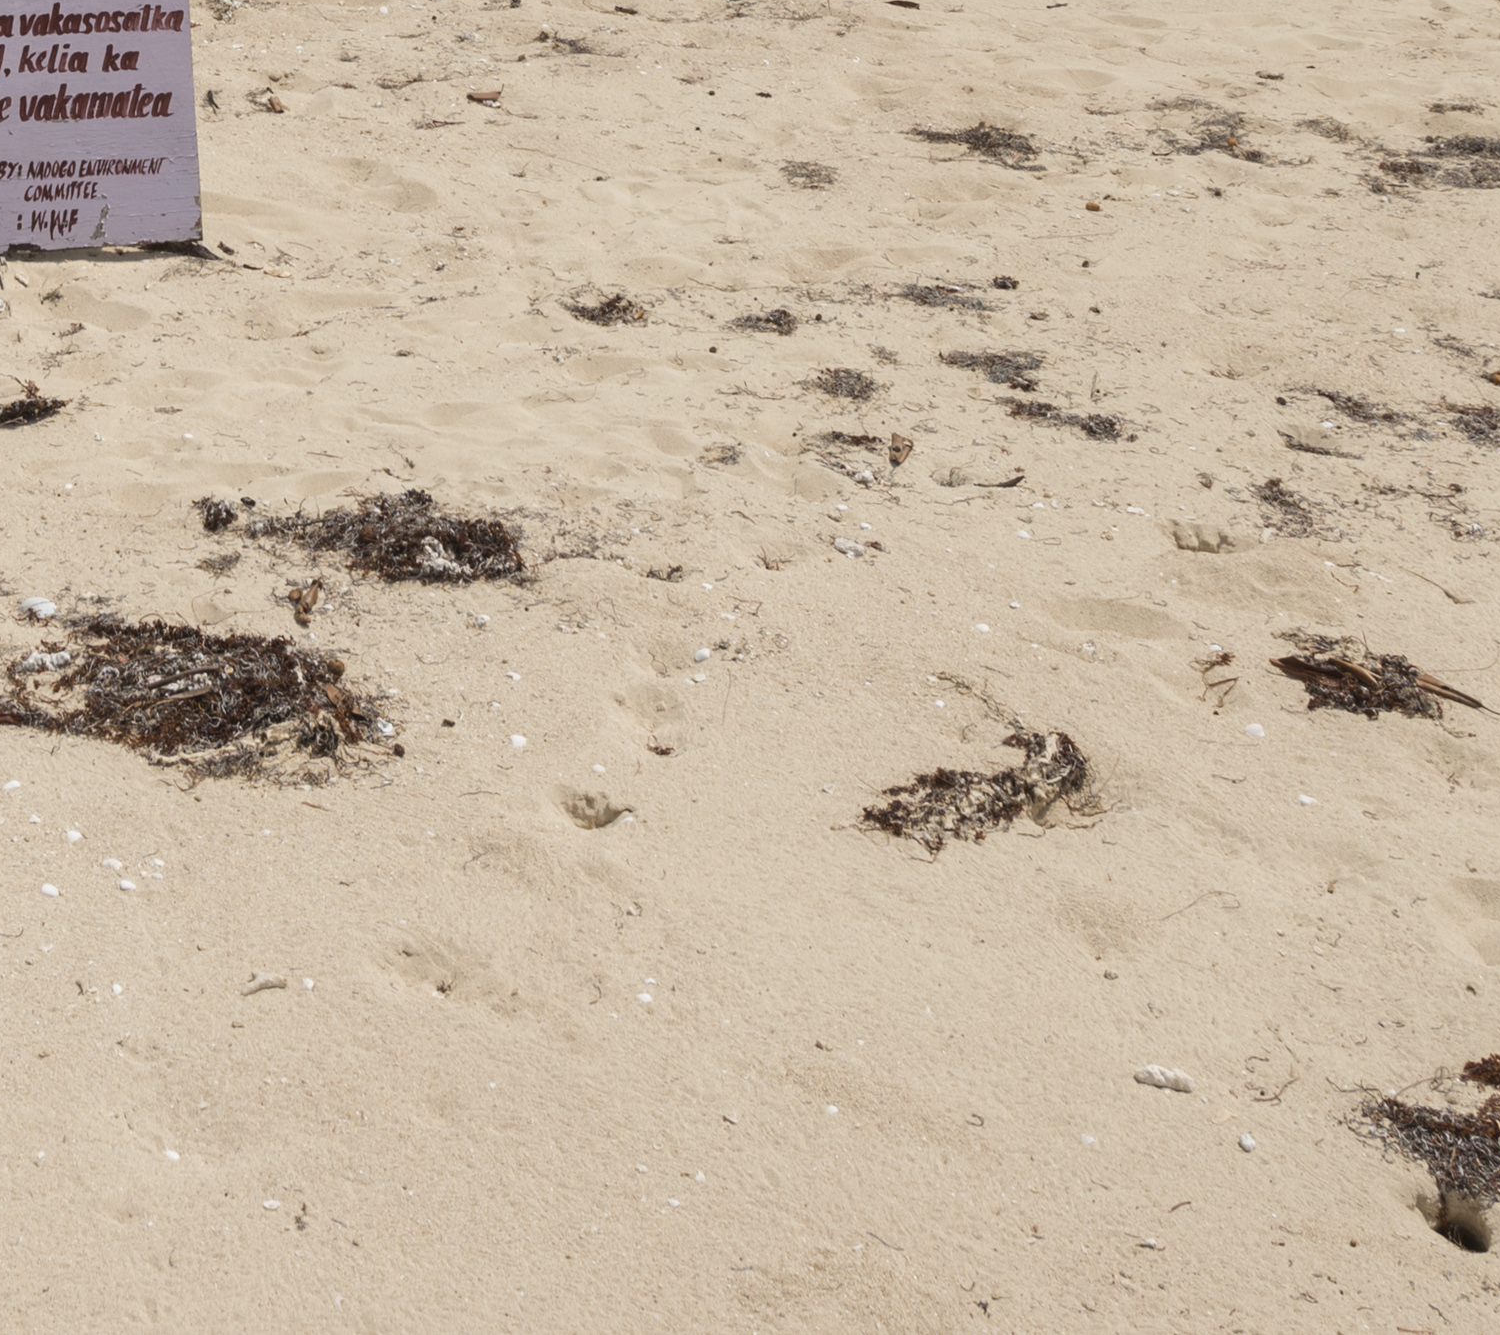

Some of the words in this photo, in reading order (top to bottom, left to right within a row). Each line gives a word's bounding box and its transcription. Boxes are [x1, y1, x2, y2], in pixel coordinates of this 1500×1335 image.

[18, 43, 89, 73] kelia
[101, 43, 140, 72] ka
[19, 83, 174, 122] vakamatea
[26, 159, 77, 181] NADOGO
[78, 157, 167, 178] ENVIRONMENT
[23, 181, 98, 203] COMMITTEE
